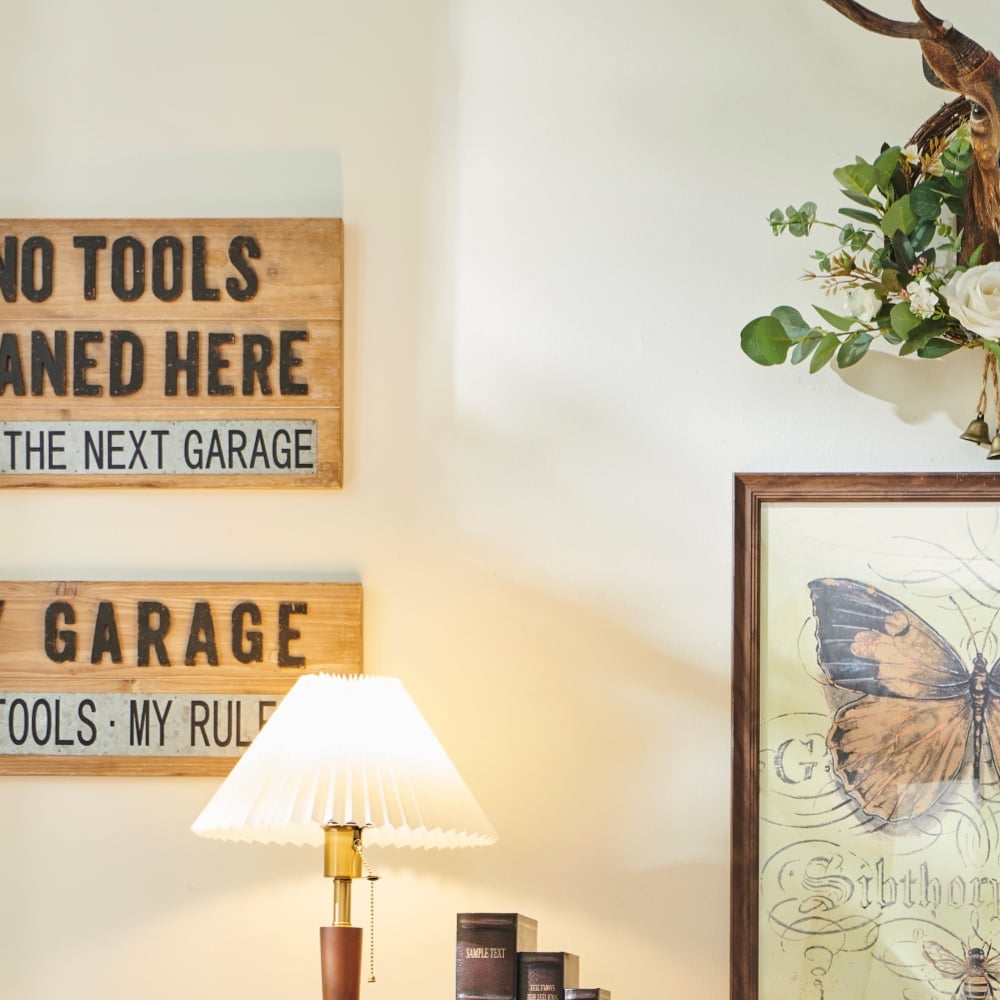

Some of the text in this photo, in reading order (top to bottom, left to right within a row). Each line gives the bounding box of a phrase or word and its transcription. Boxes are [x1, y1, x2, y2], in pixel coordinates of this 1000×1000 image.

[73, 236, 261, 303] TOOLS
[0, 330, 309, 397] ANED HERE
[4, 429, 314, 470] THE NEXT GARAGE
[44, 601, 309, 668] GARAGE
[0, 699, 98, 747] OOLS
[130, 700, 172, 747] MY
[466, 947, 507, 959] SAMPLE TEXT
